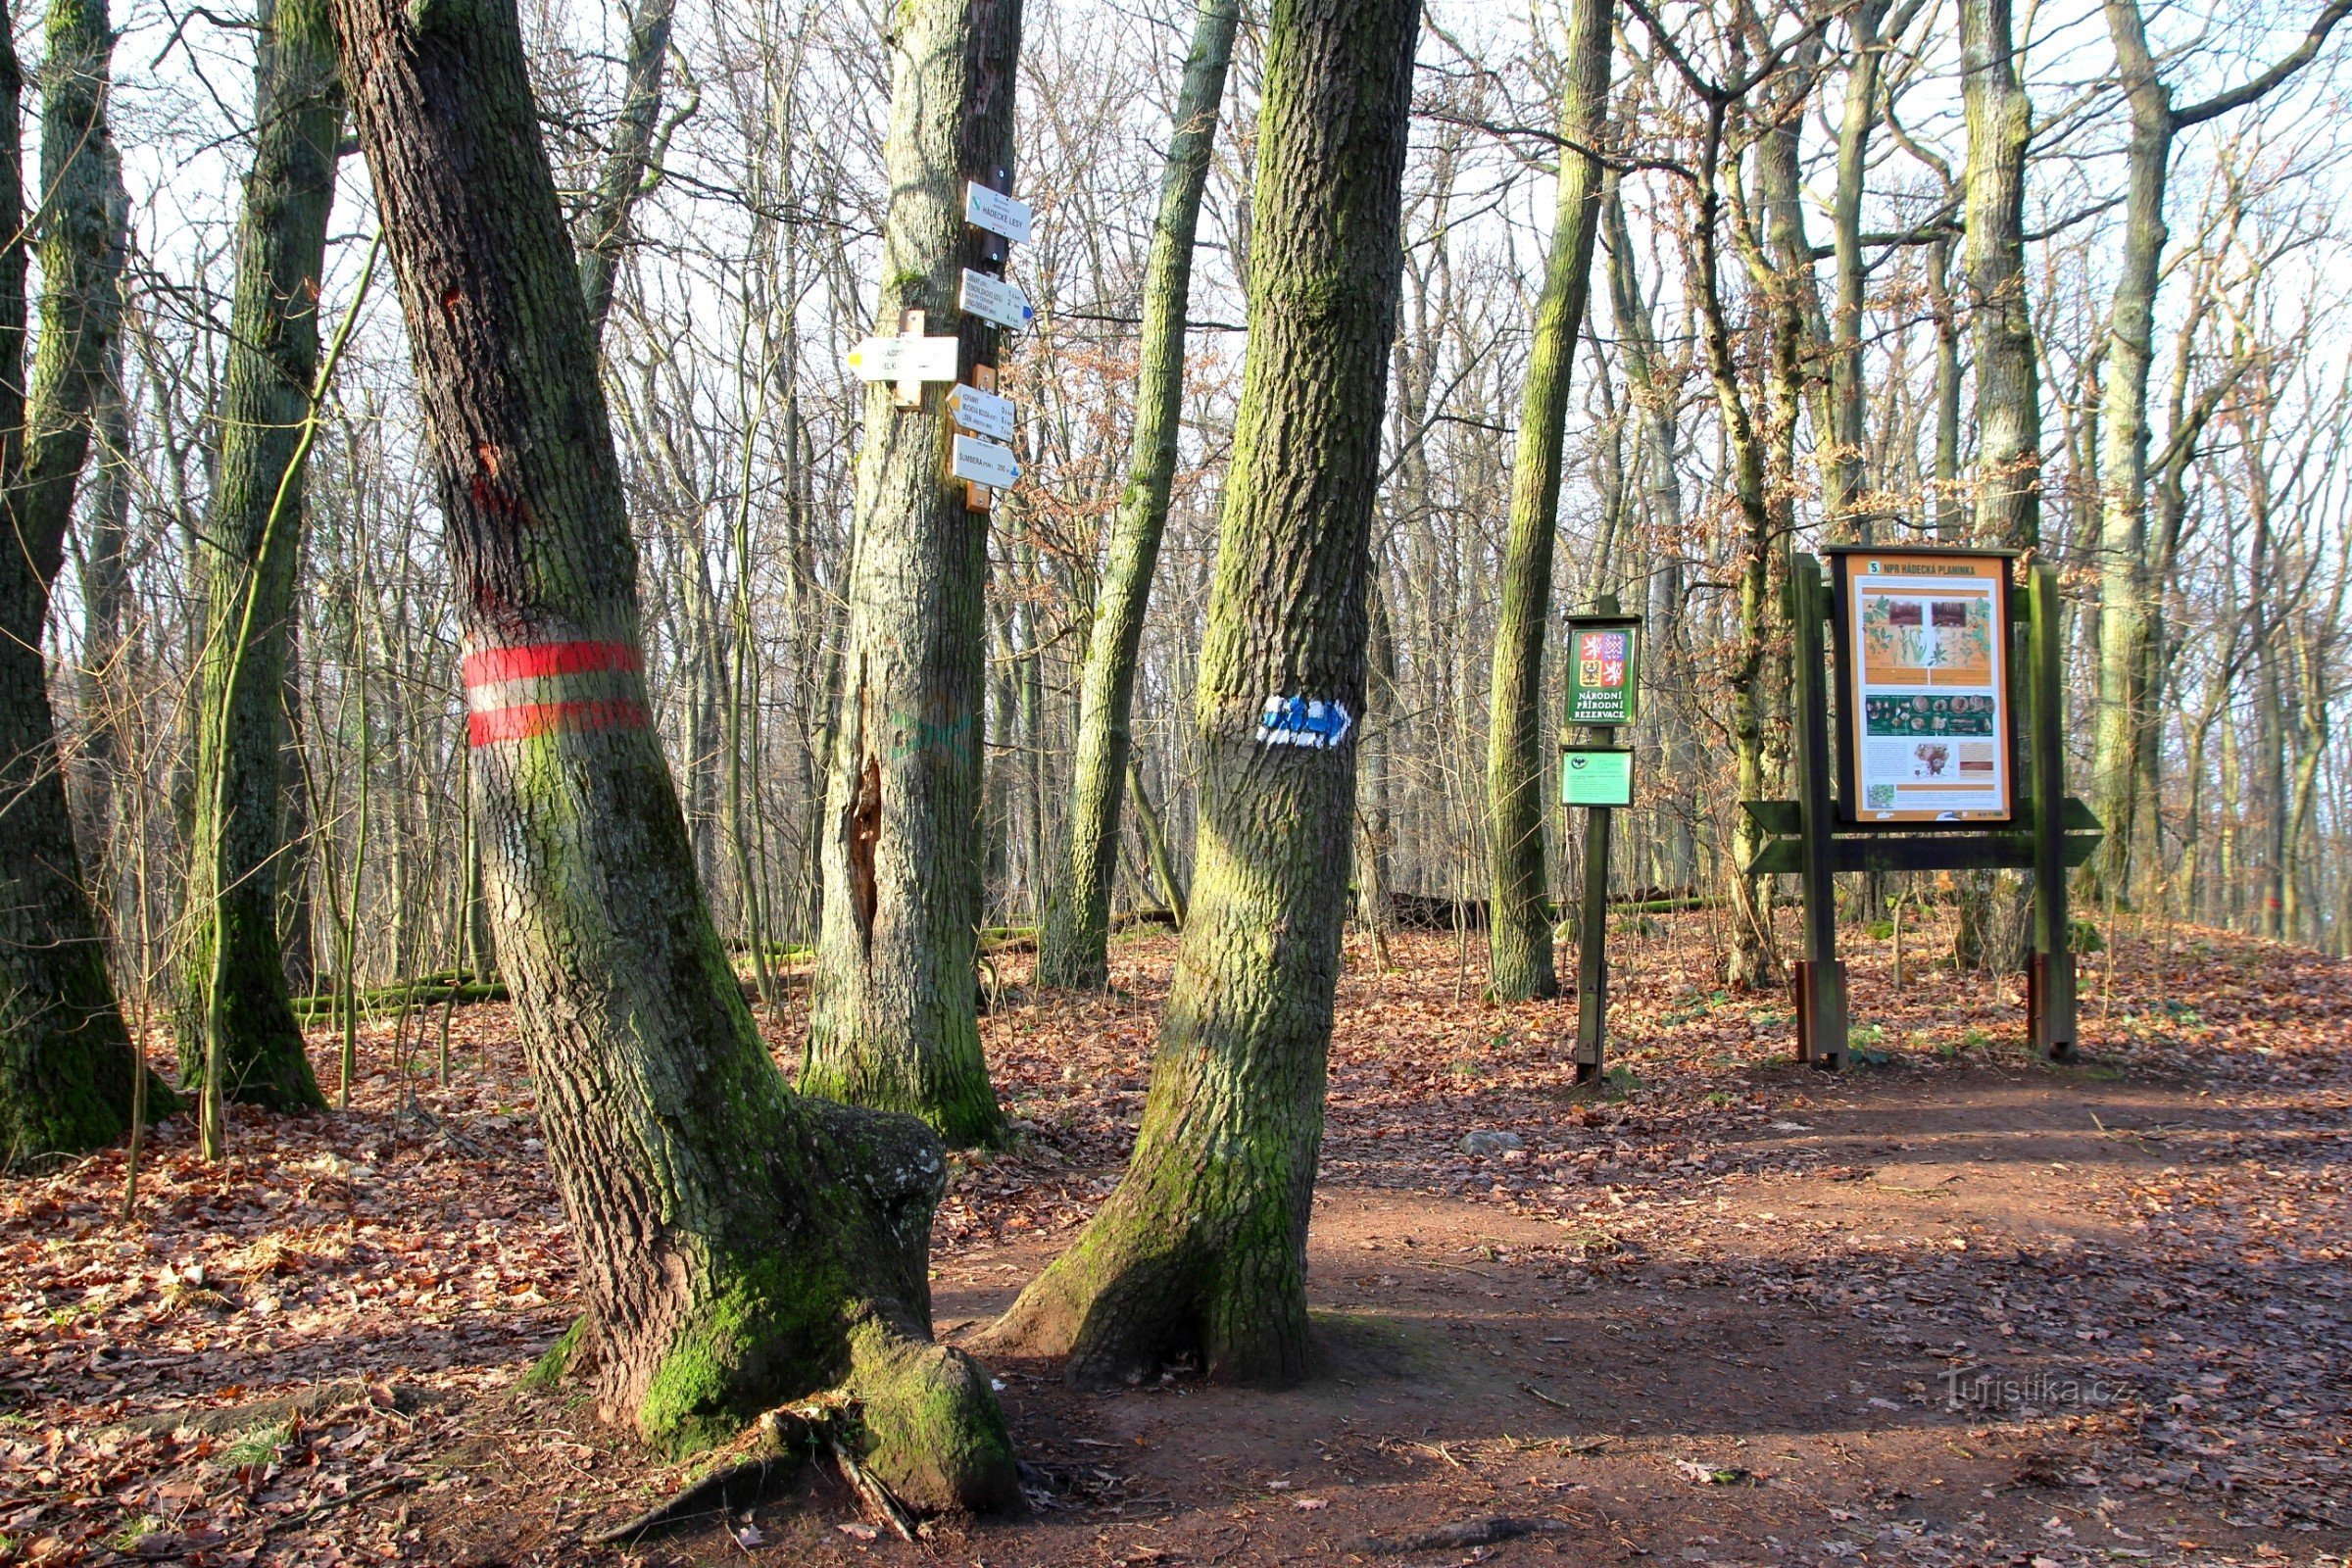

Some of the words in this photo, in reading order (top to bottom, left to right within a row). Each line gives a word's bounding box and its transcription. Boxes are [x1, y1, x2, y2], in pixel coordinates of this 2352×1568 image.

[982, 206, 1007, 223] HÁDECKÉ
[1009, 218, 1022, 229] LESY
[1872, 563, 1877, 572] 5
[1884, 564, 1899, 573] NPR
[1901, 563, 1936, 574] HÁDECKÁ
[1938, 565, 1976, 575] PLANINKA
[1578, 690, 1623, 700] NÁRODNÍ
[1576, 700, 1624, 710] PŘÍRODNÍ
